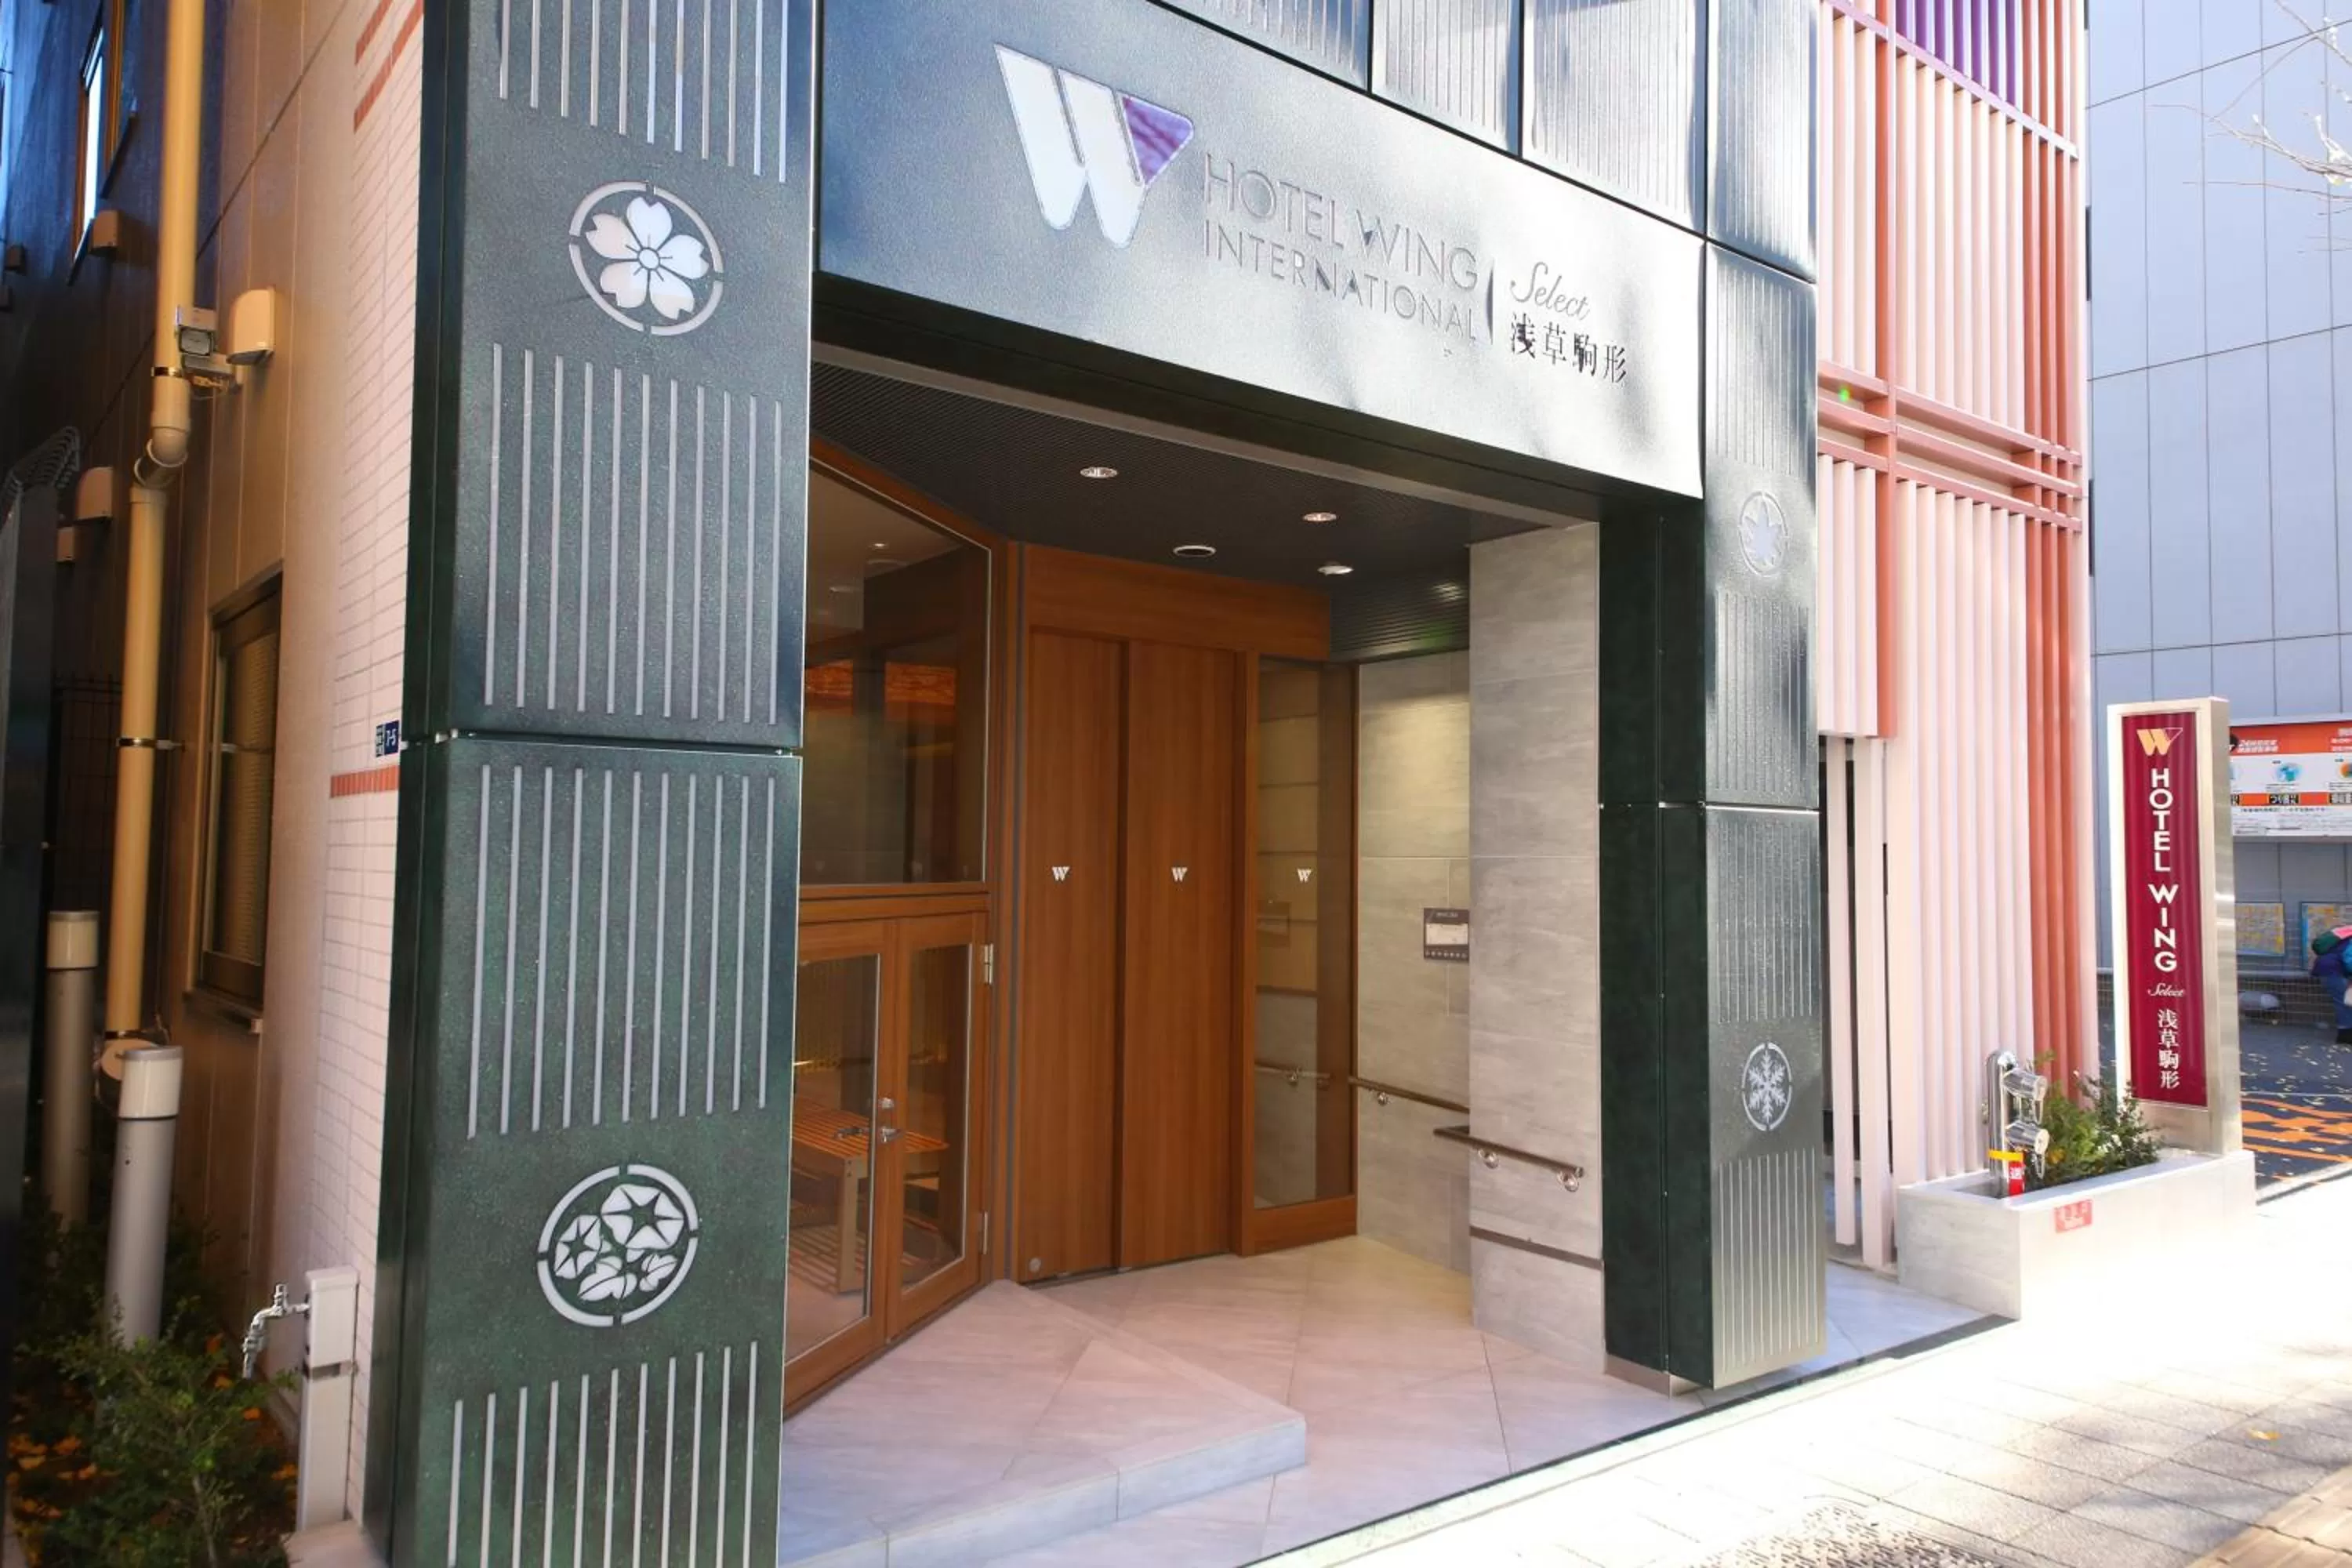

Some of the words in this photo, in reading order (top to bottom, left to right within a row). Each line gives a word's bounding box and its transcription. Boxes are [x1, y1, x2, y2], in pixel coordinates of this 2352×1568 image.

[1203, 153, 1344, 249] HOTEL
[1356, 209, 1479, 291] WING
[1203, 220, 1476, 340] INTERNATIONAL
[1510, 261, 1591, 321] Select
[1511, 312, 1627, 383] 浅草駒形
[2149, 768, 2173, 872] HOTEL
[2147, 884, 2179, 972] WING
[2147, 982, 2185, 996] Select
[2158, 1009, 2180, 1089] 浅草駒形
